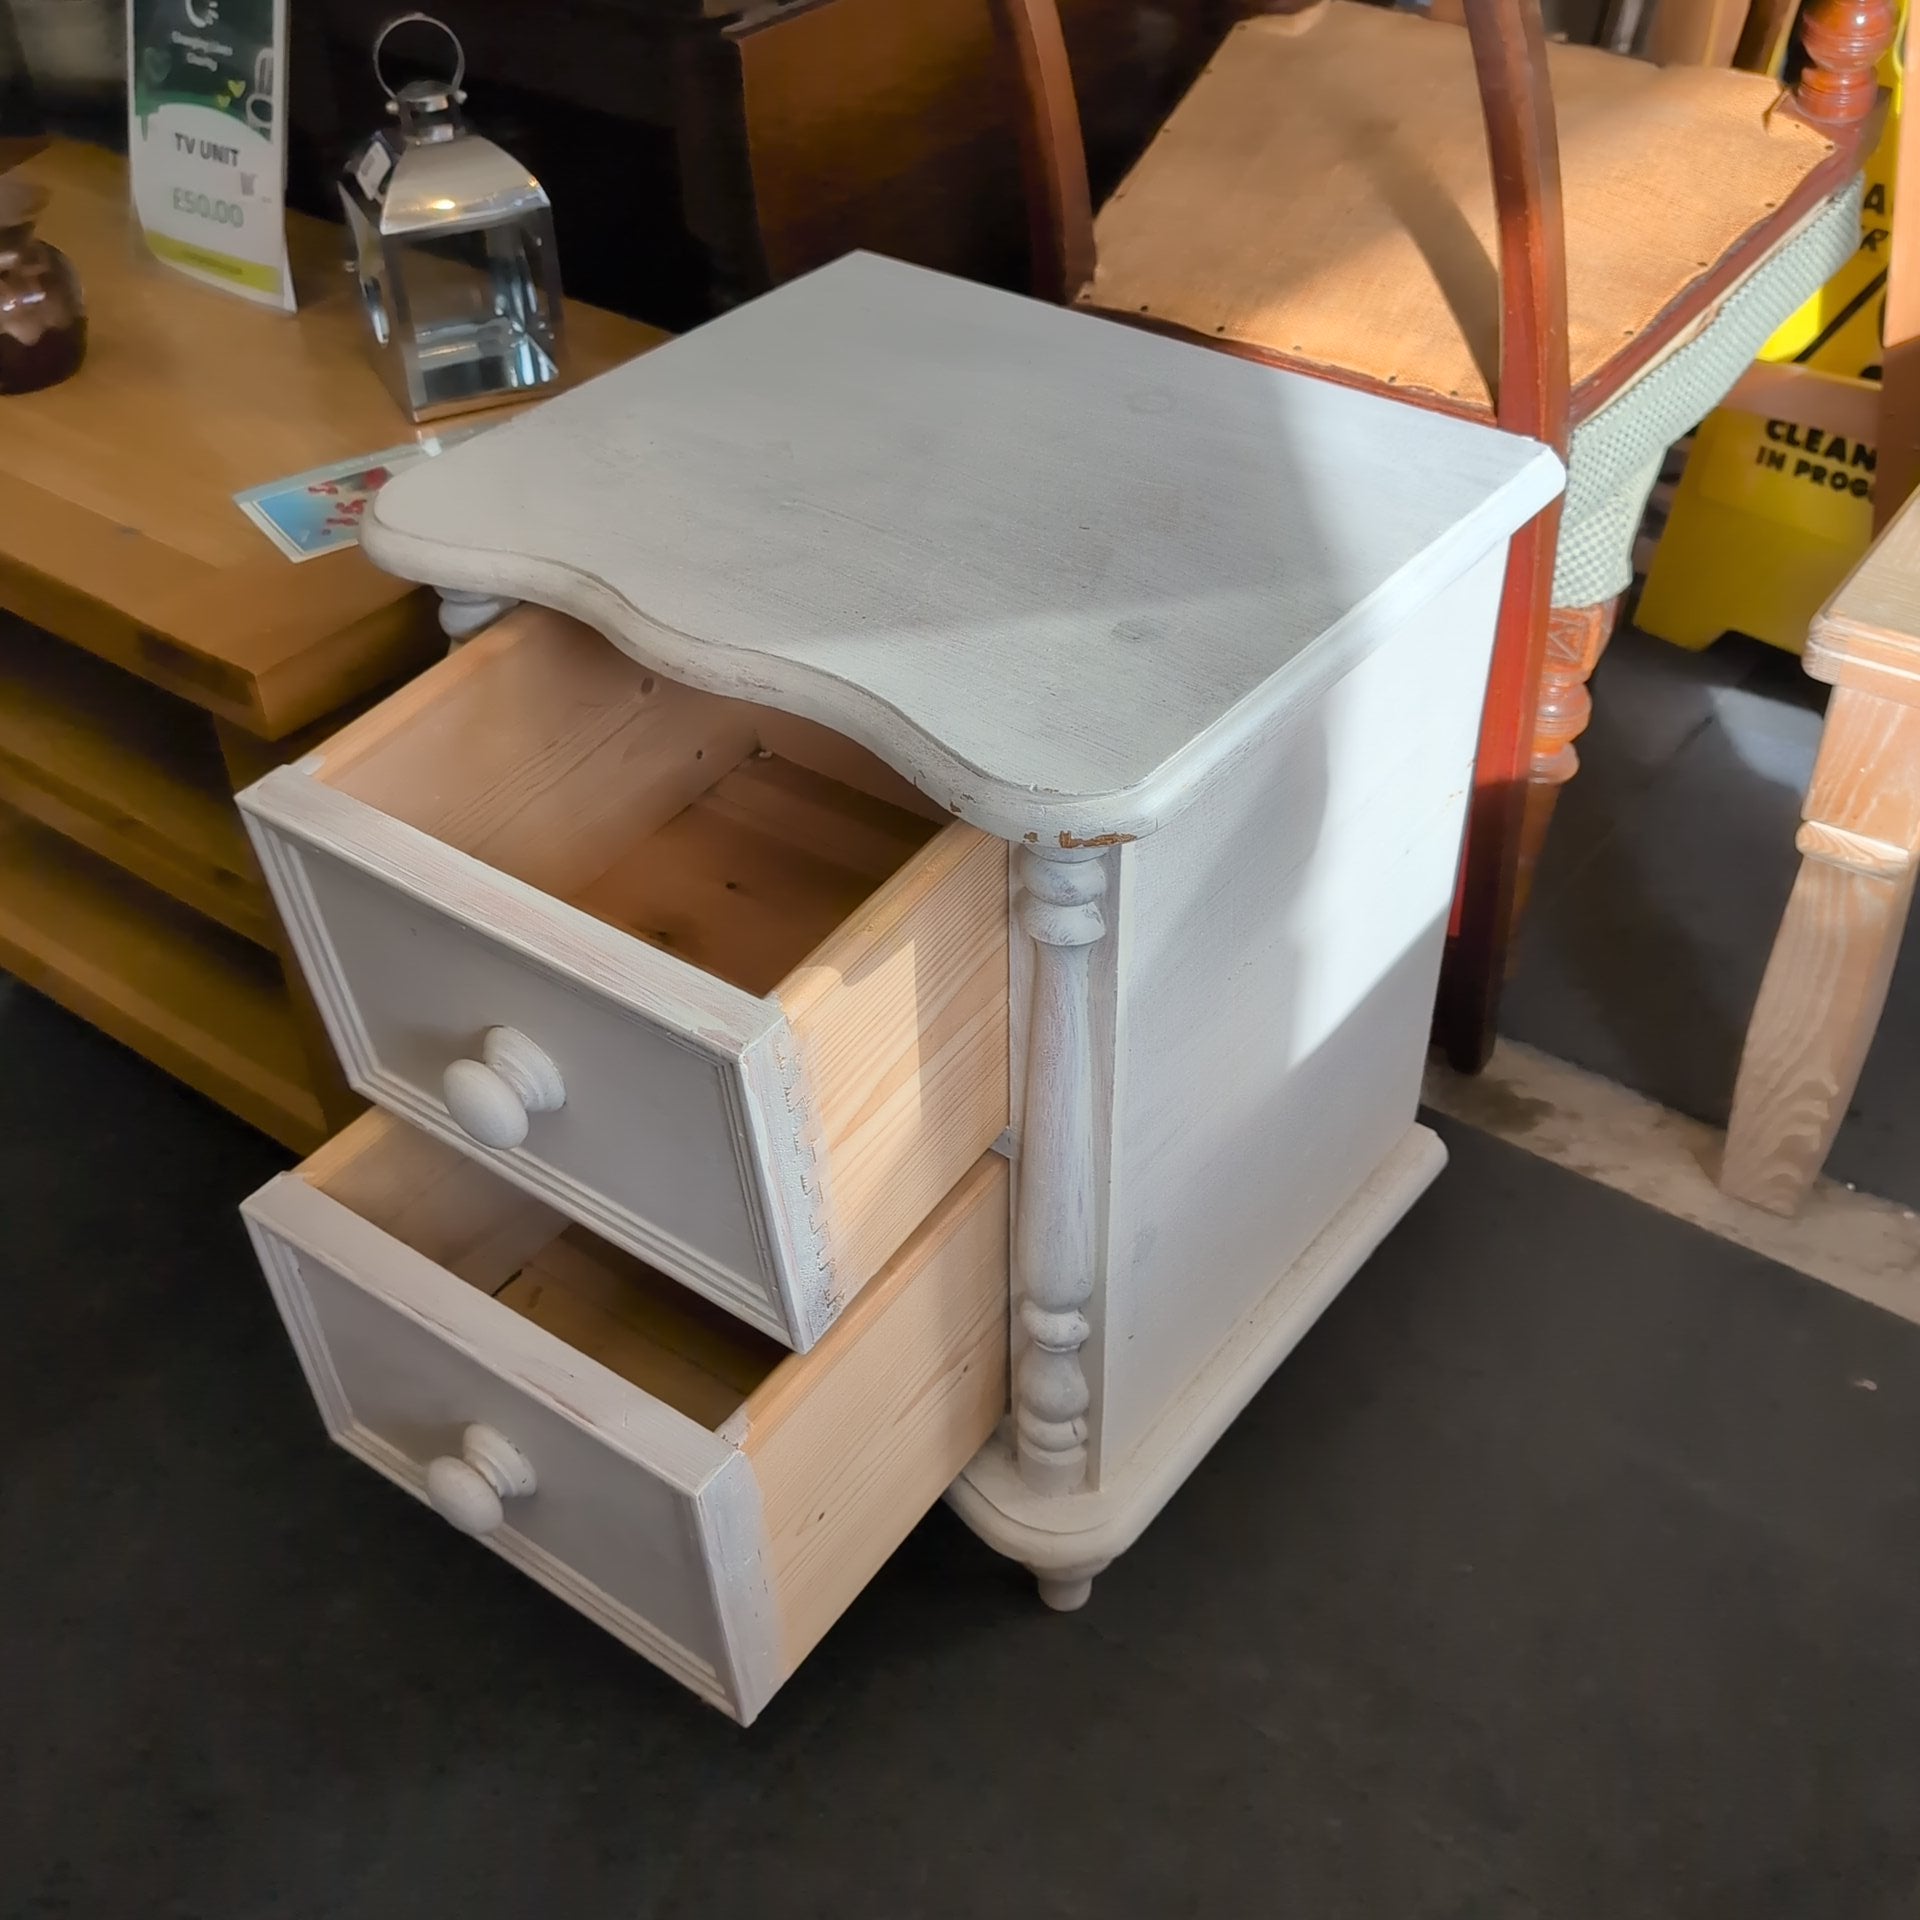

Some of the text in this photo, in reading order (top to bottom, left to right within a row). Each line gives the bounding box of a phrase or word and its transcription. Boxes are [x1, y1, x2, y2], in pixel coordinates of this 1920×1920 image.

[174, 132, 239, 167] TV UNIT
[1756, 445, 1875, 503] IN PROG
